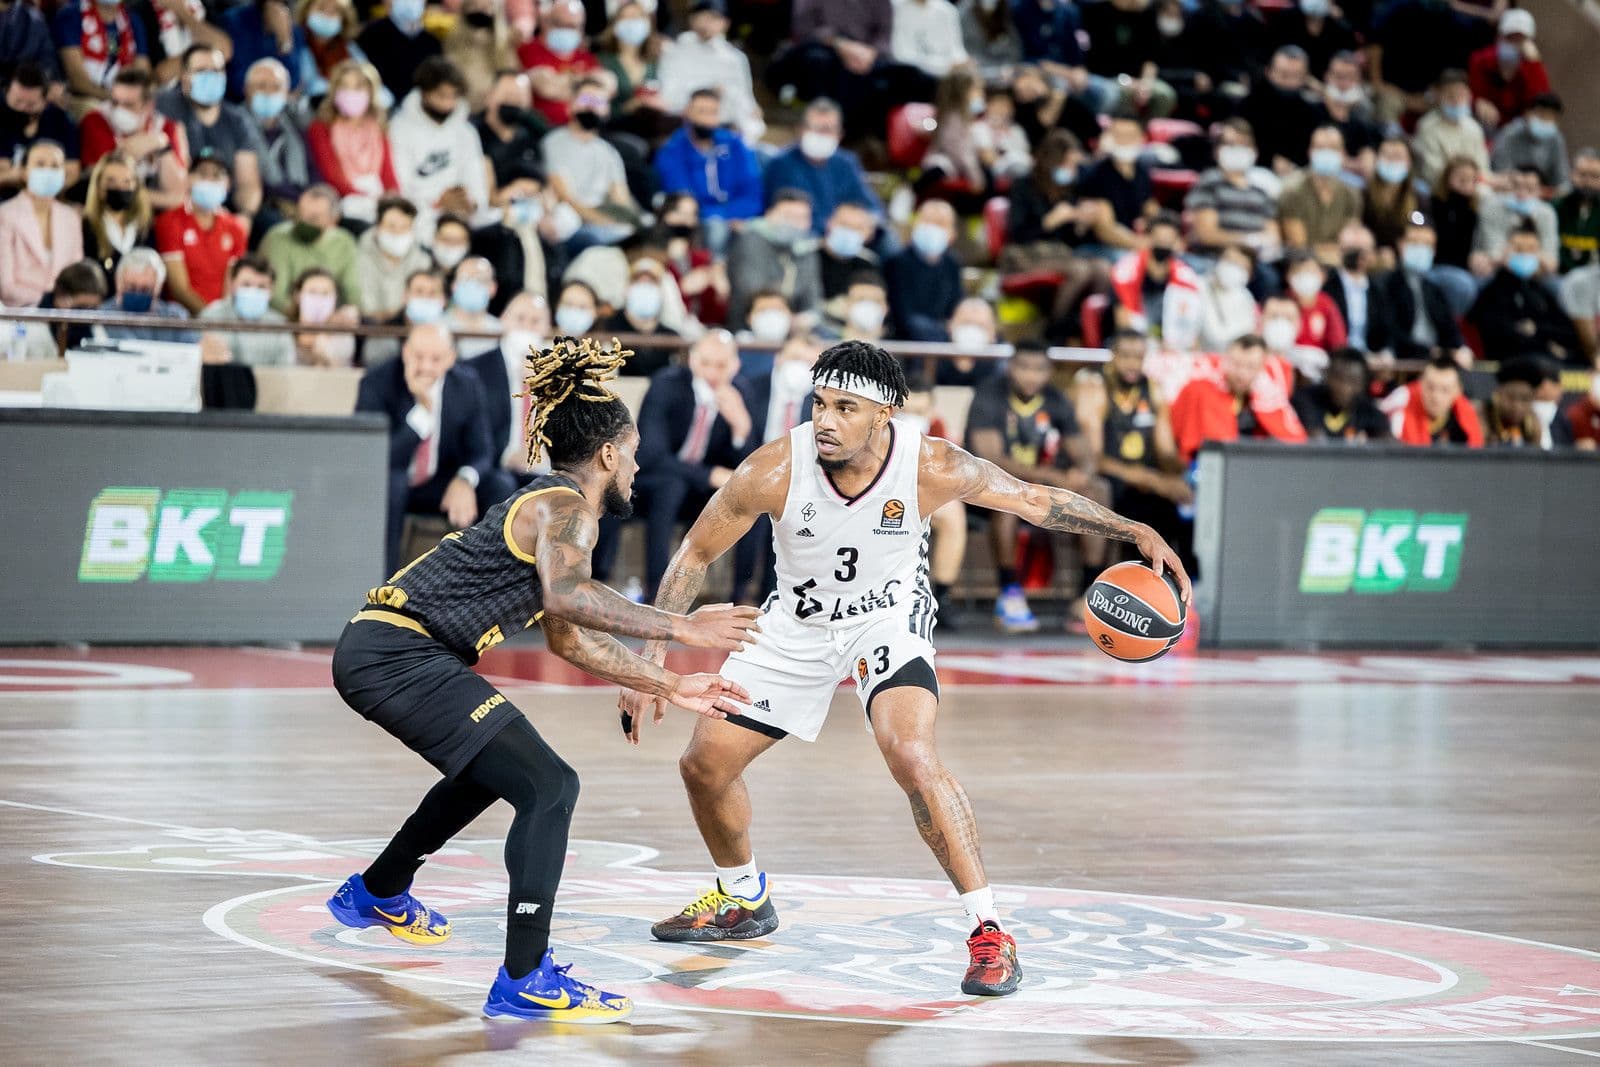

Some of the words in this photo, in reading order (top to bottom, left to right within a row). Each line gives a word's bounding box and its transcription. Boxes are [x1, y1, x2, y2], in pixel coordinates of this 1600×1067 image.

[85, 502, 287, 568] BKT
[1304, 521, 1464, 581] BKT
[834, 547, 859, 582] 3
[1089, 590, 1152, 634] SPALDING
[873, 645, 890, 675] 3
